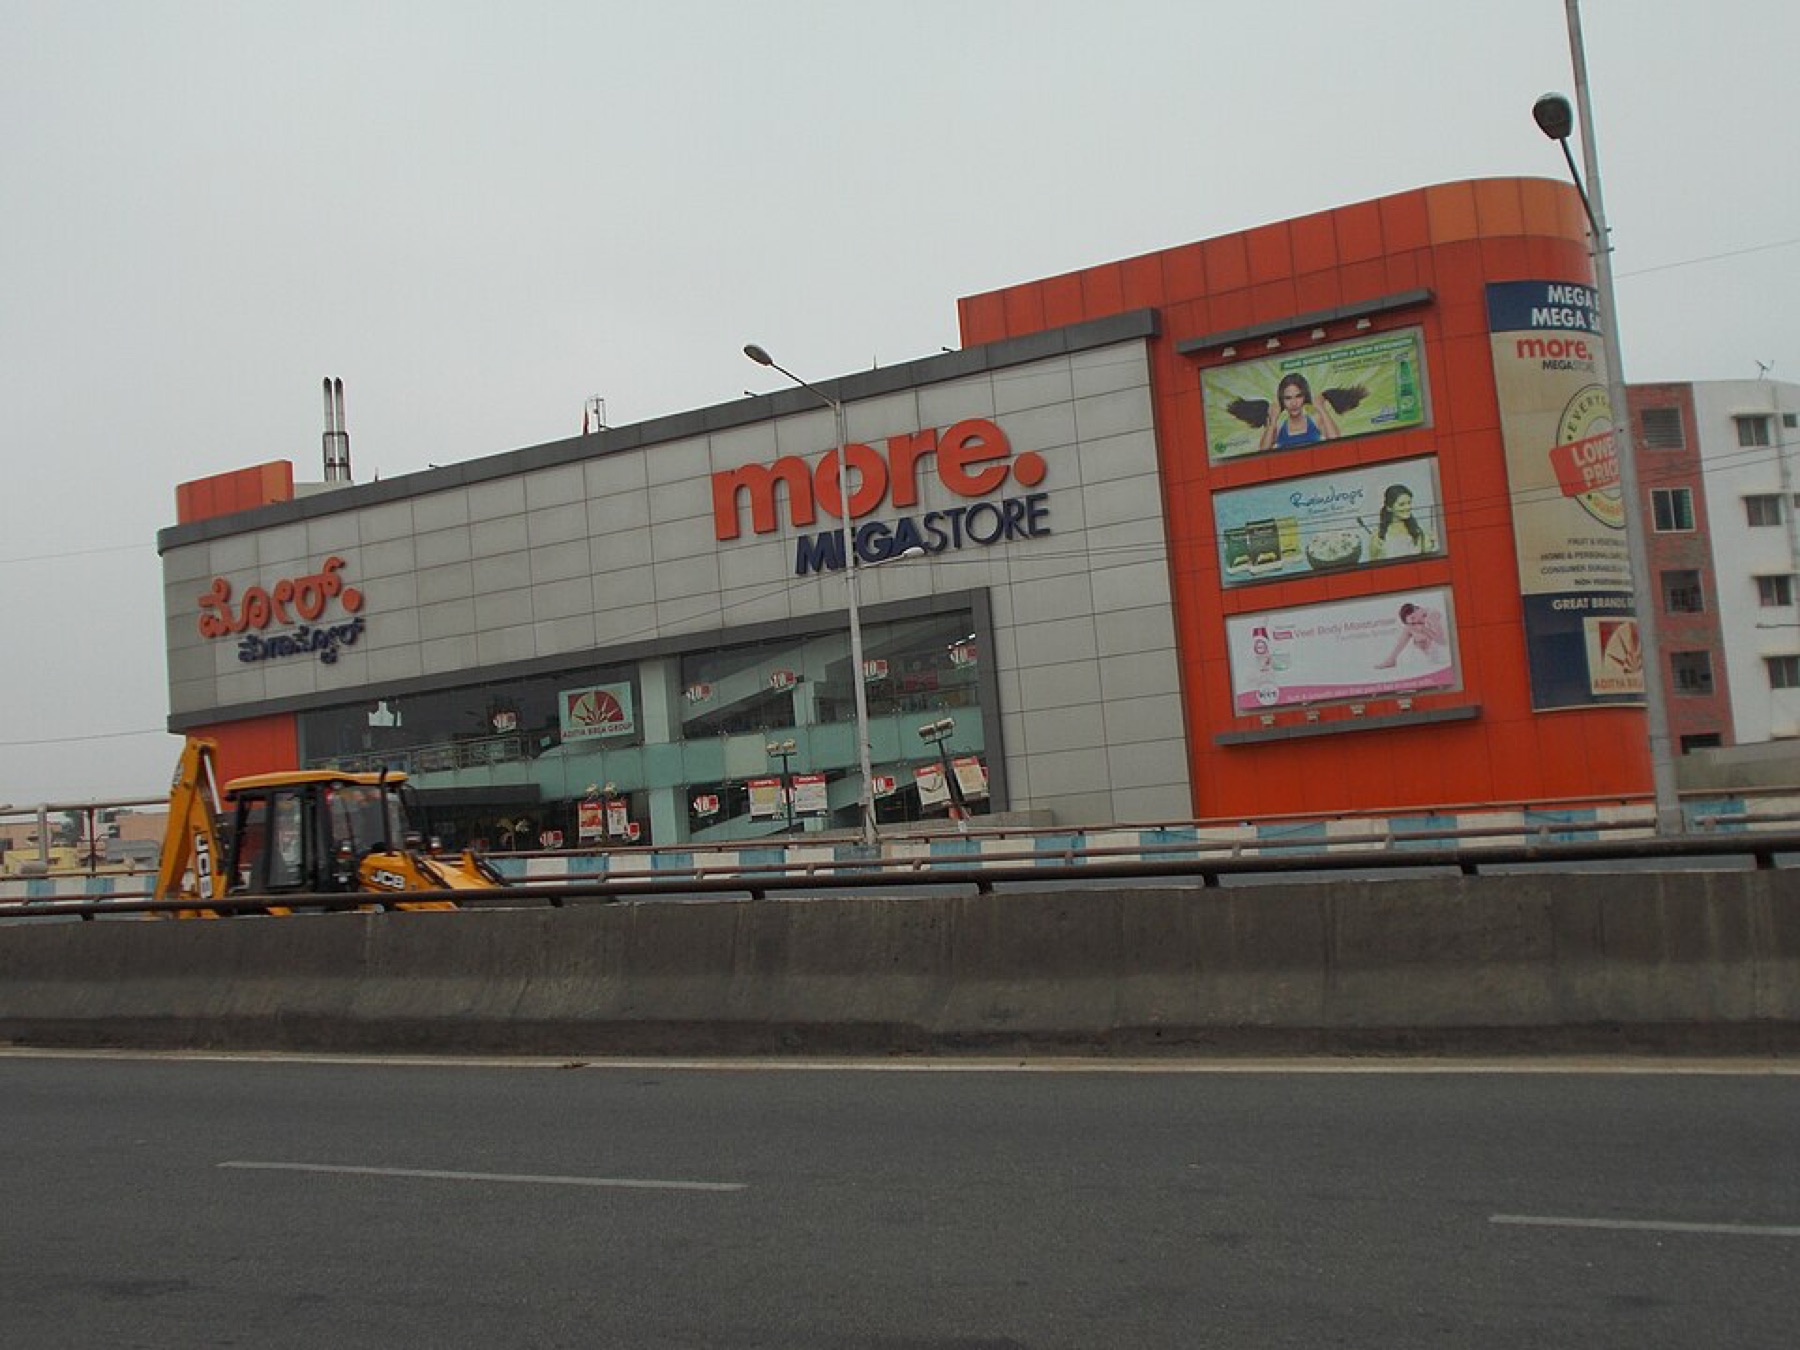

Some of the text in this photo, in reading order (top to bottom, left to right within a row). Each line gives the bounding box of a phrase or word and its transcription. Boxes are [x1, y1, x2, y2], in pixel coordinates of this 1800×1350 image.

[1547, 285, 1594, 308] MEGA
[1531, 307, 1587, 328] MEGA
[1516, 337, 1594, 361] more.
[1572, 436, 1616, 468] LOWE
[711, 418, 1046, 541] more.
[794, 493, 1051, 575] MEGASTORE
[1552, 598, 1589, 610] GREAT
[370, 869, 406, 890] JCB
